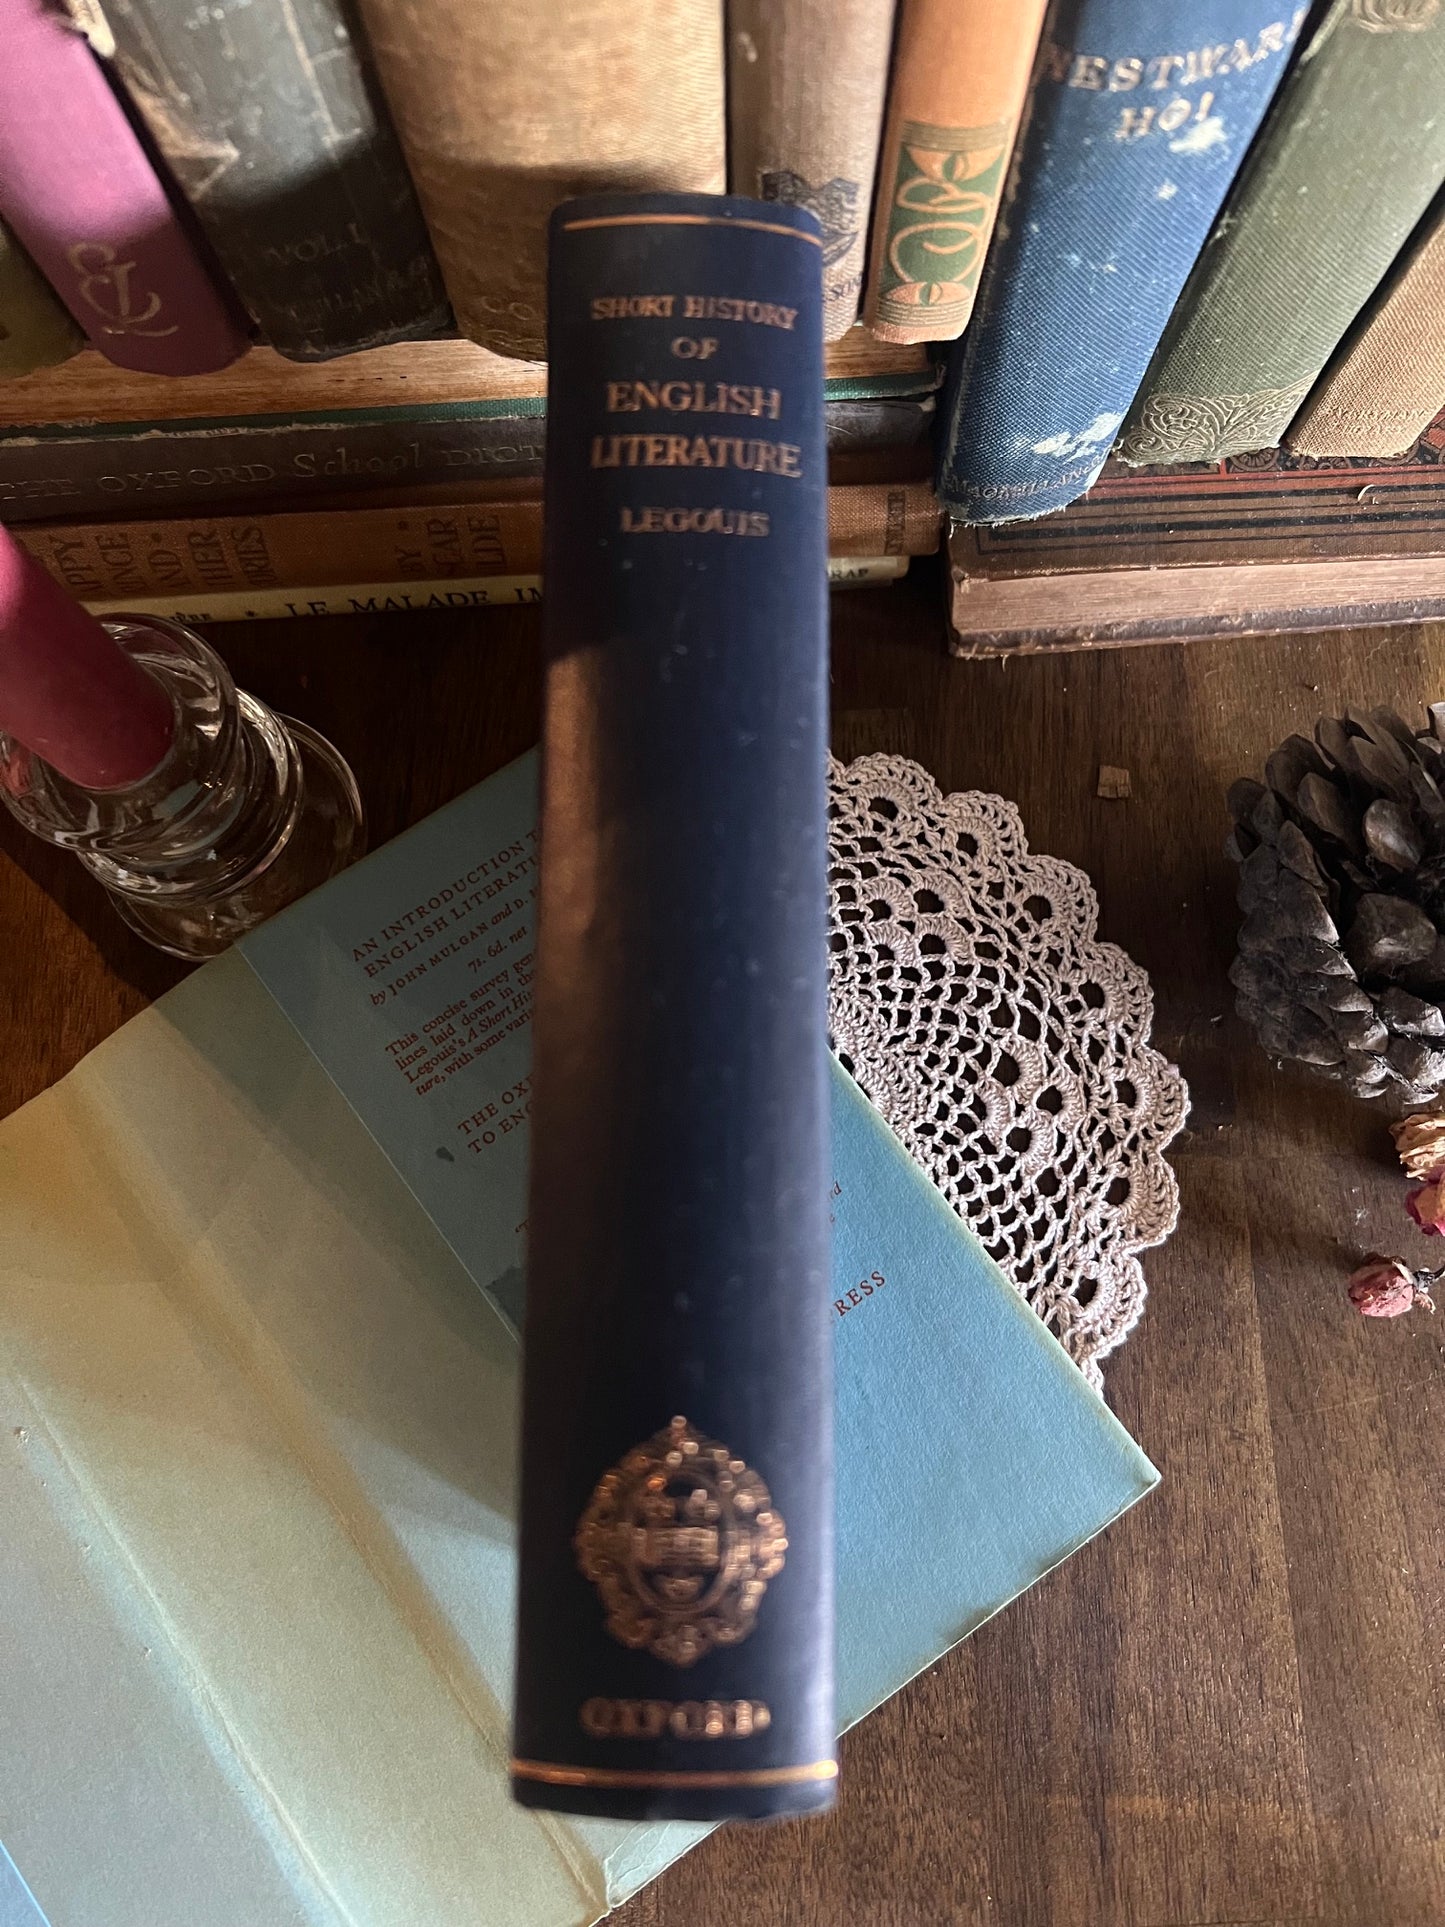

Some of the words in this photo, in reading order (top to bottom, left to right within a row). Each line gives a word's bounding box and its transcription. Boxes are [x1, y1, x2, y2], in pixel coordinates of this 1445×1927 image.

[1114, 91, 1215, 139] HO!
[591, 295, 675, 320] SHORT
[682, 295, 798, 330] HISTORY
[671, 336, 718, 360] OF
[606, 380, 781, 420] ENGLISH
[97, 463, 275, 492] OXFORD
[293, 443, 421, 480] School
[591, 433, 802, 478] LITERATURE
[620, 505, 770, 537] LEGOUIS
[348, 590, 491, 614] MALADE
[351, 936, 379, 962] AN
[380, 840, 526, 942] INTRODUCTION
[363, 916, 450, 978] ENGLISH
[369, 989, 387, 1006] by
[387, 963, 428, 996] JOHN
[428, 922, 490, 967] MULGAN
[490, 903, 513, 926] and
[508, 926, 528, 944] net
[385, 1031, 420, 1056] This
[422, 998, 469, 1034] concise
[469, 968, 510, 1002] survey
[394, 1044, 428, 1071] lines
[430, 1023, 457, 1047] laid
[460, 999, 496, 1027] down
[499, 986, 515, 1000] in
[403, 1038, 467, 1084] Legouis's
[467, 1027, 479, 1043] A
[478, 1004, 514, 1034] Short
[415, 1073, 447, 1097] ture,
[444, 1051, 474, 1075] with
[473, 1028, 507, 1056] some
[457, 1102, 499, 1135] THE
[467, 1130, 496, 1155] TO
[830, 1270, 886, 1318] RESS
